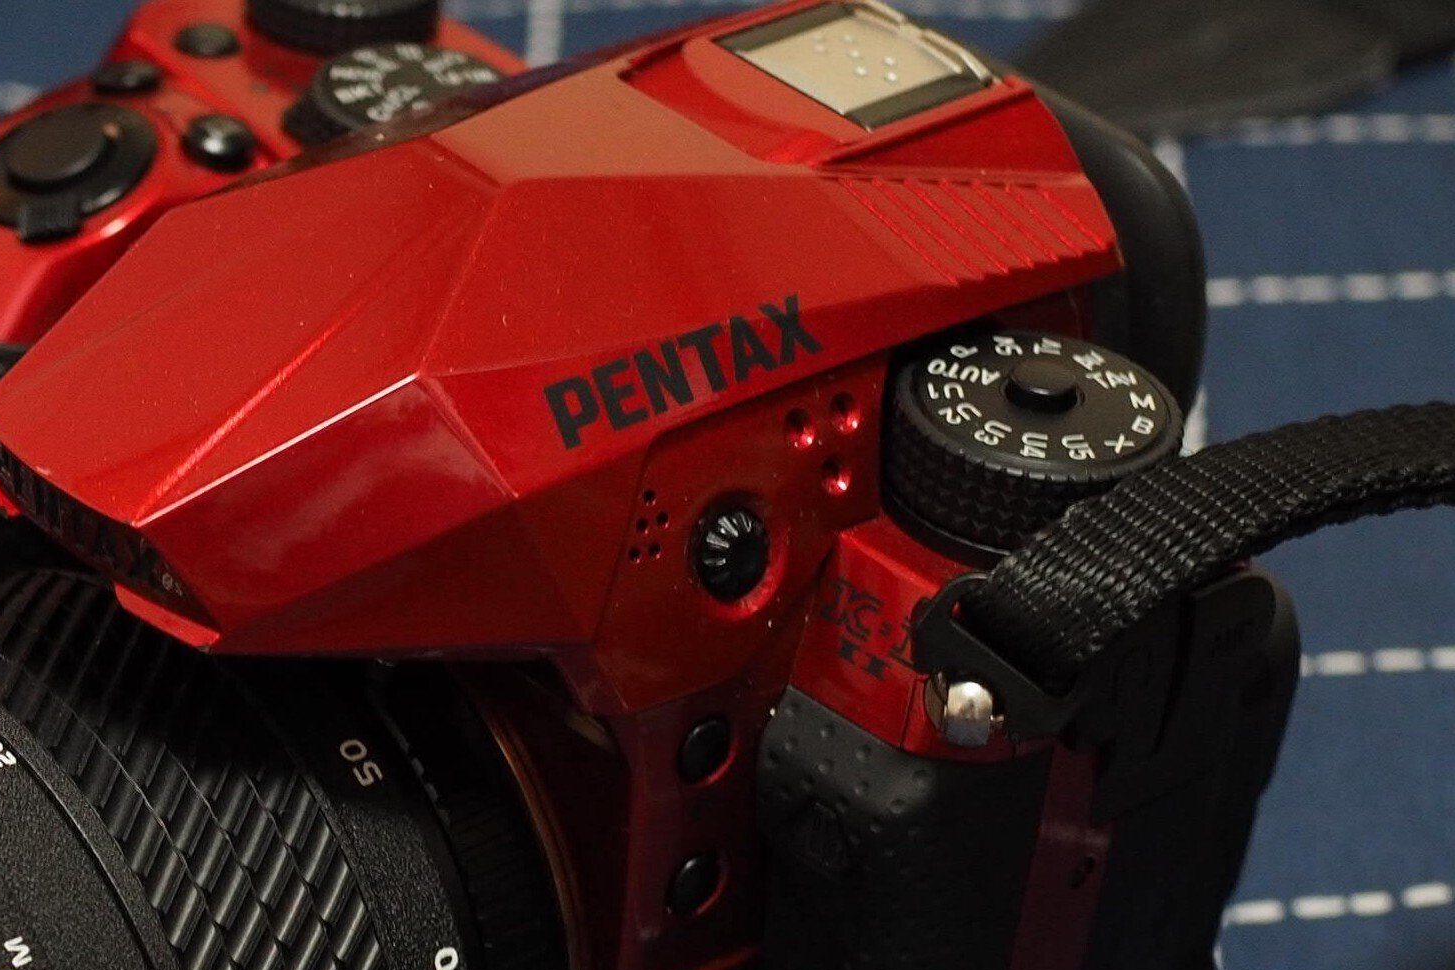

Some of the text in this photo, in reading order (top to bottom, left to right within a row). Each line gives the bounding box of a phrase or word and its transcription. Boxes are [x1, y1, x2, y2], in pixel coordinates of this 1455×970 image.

[950, 345, 978, 359] P
[543, 294, 824, 451] PENTAX
[927, 358, 1001, 386] AUTO
[927, 382, 964, 400] U1
[1129, 391, 1156, 411] M
[938, 402, 982, 425] U2
[1131, 415, 1155, 434] B
[974, 420, 1012, 446] U3
[1020, 432, 1049, 459] U4
[1103, 432, 1135, 454] X
[1061, 434, 1096, 460] U5
[340, 739, 384, 787] 50
[3, 936, 33, 968] M
